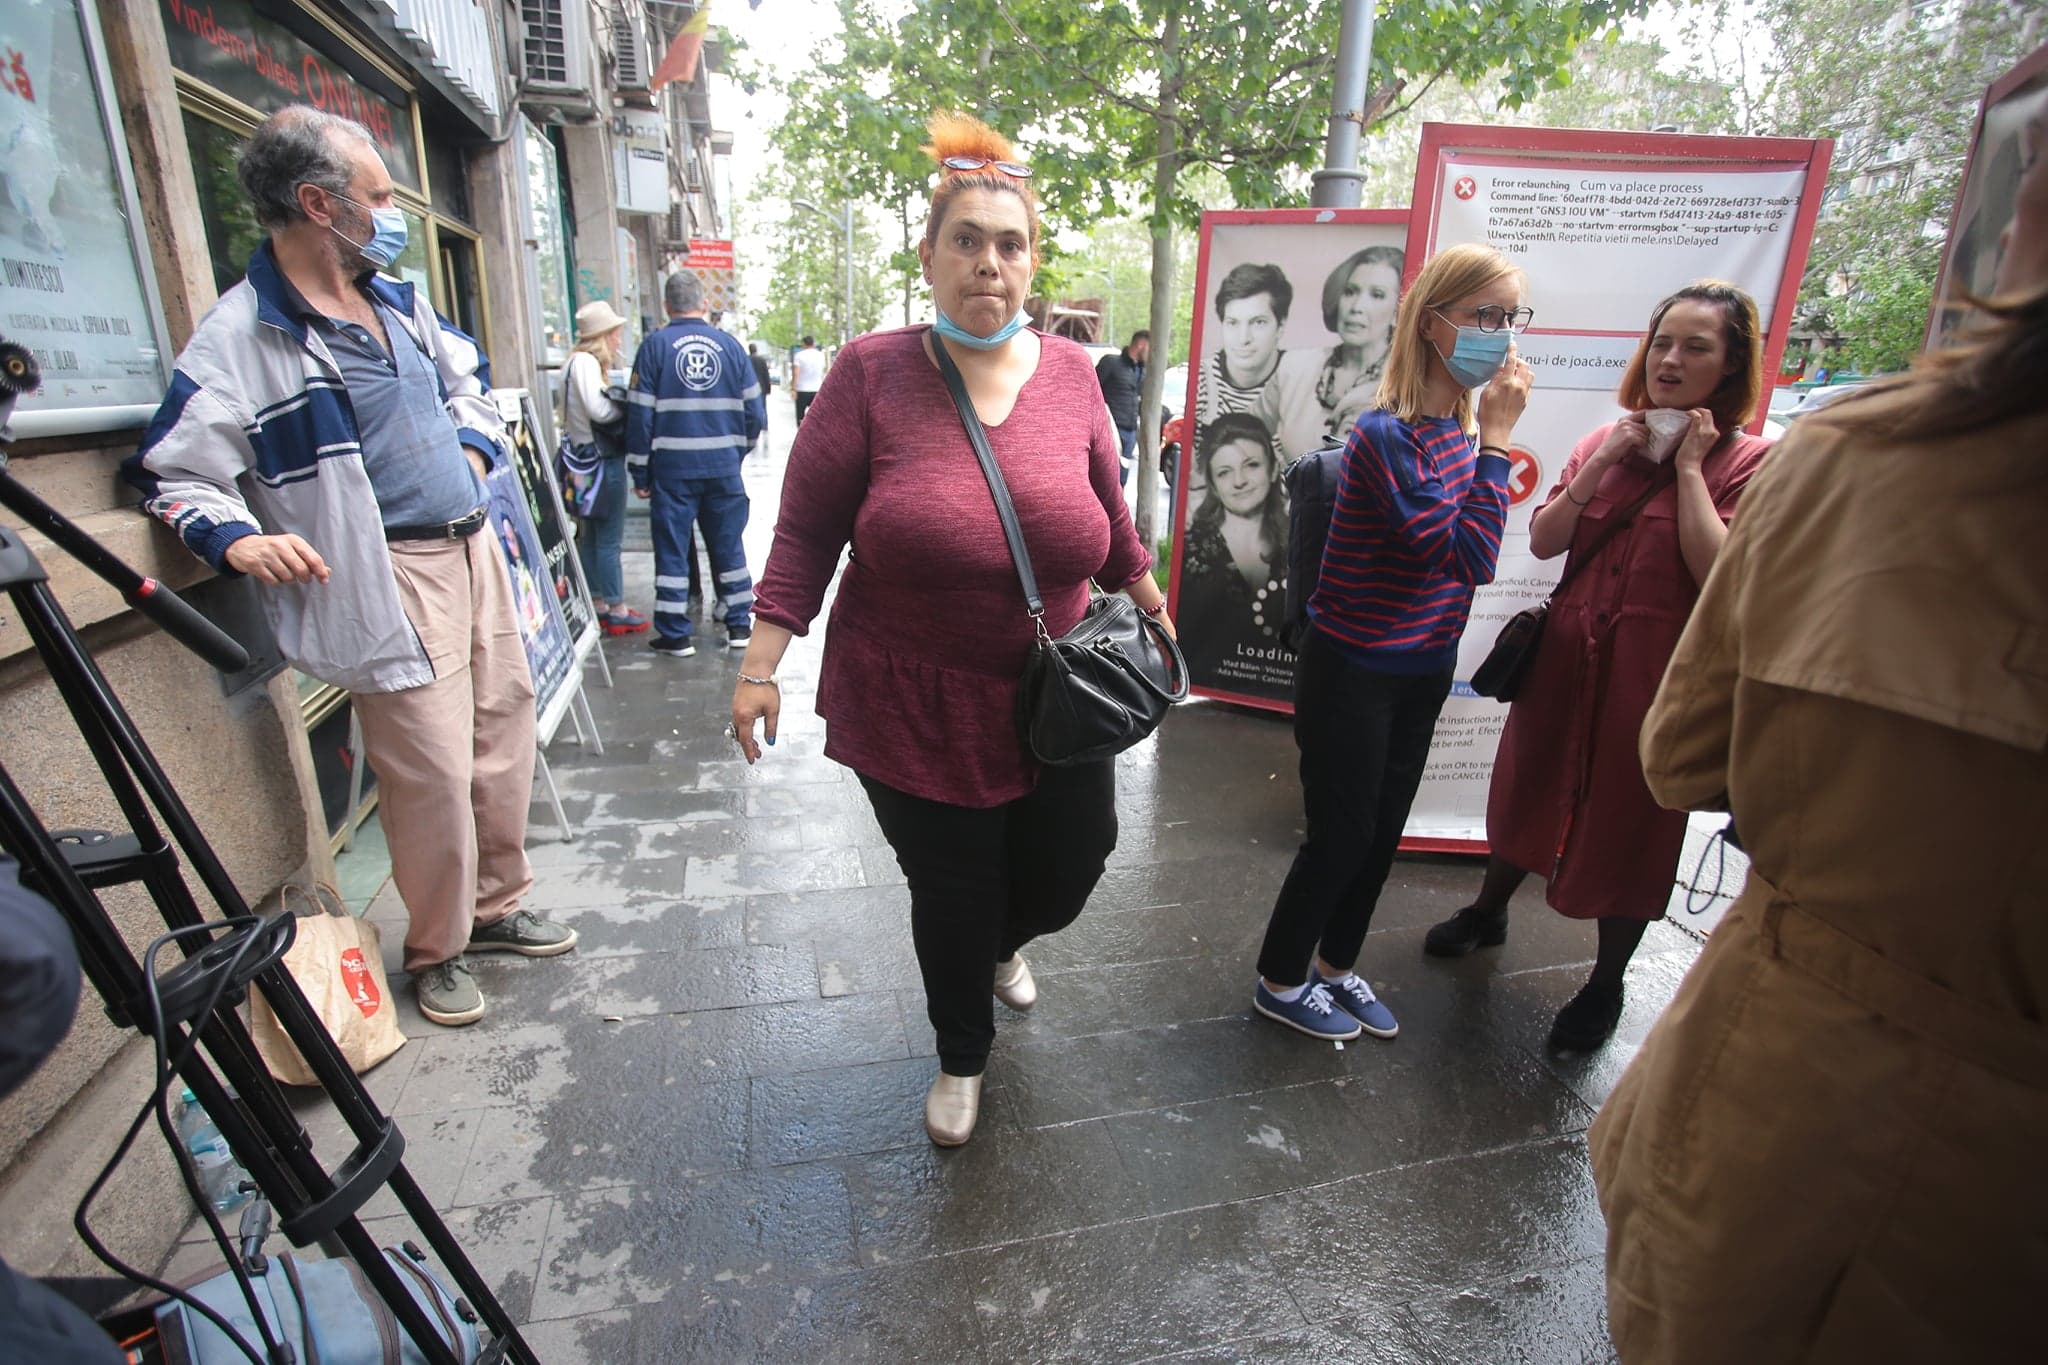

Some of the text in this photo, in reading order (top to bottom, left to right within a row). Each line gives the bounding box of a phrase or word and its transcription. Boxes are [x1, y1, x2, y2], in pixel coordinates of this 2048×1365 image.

[170, 0, 250, 65] Vindem
[251, 35, 299, 96] bilete
[1492, 178, 1514, 188] Error
[1517, 180, 1570, 191] relaunching
[1580, 180, 1606, 191] Cum
[1625, 182, 1656, 194] place
[1659, 184, 1703, 194] process
[1490, 191, 1536, 202] Command
[1489, 206, 1533, 214] comment
[1559, 232, 1602, 243] Repetitia
[1605, 234, 1629, 244] vietii
[1551, 355, 1567, 366] de
[1530, 577, 1556, 588] Cânte
[1505, 589, 1519, 598] not
[1521, 589, 1533, 598] be
[1442, 739, 1452, 748] be
[1454, 760, 1467, 769] OK
[1452, 772, 1487, 781] CANCEL
